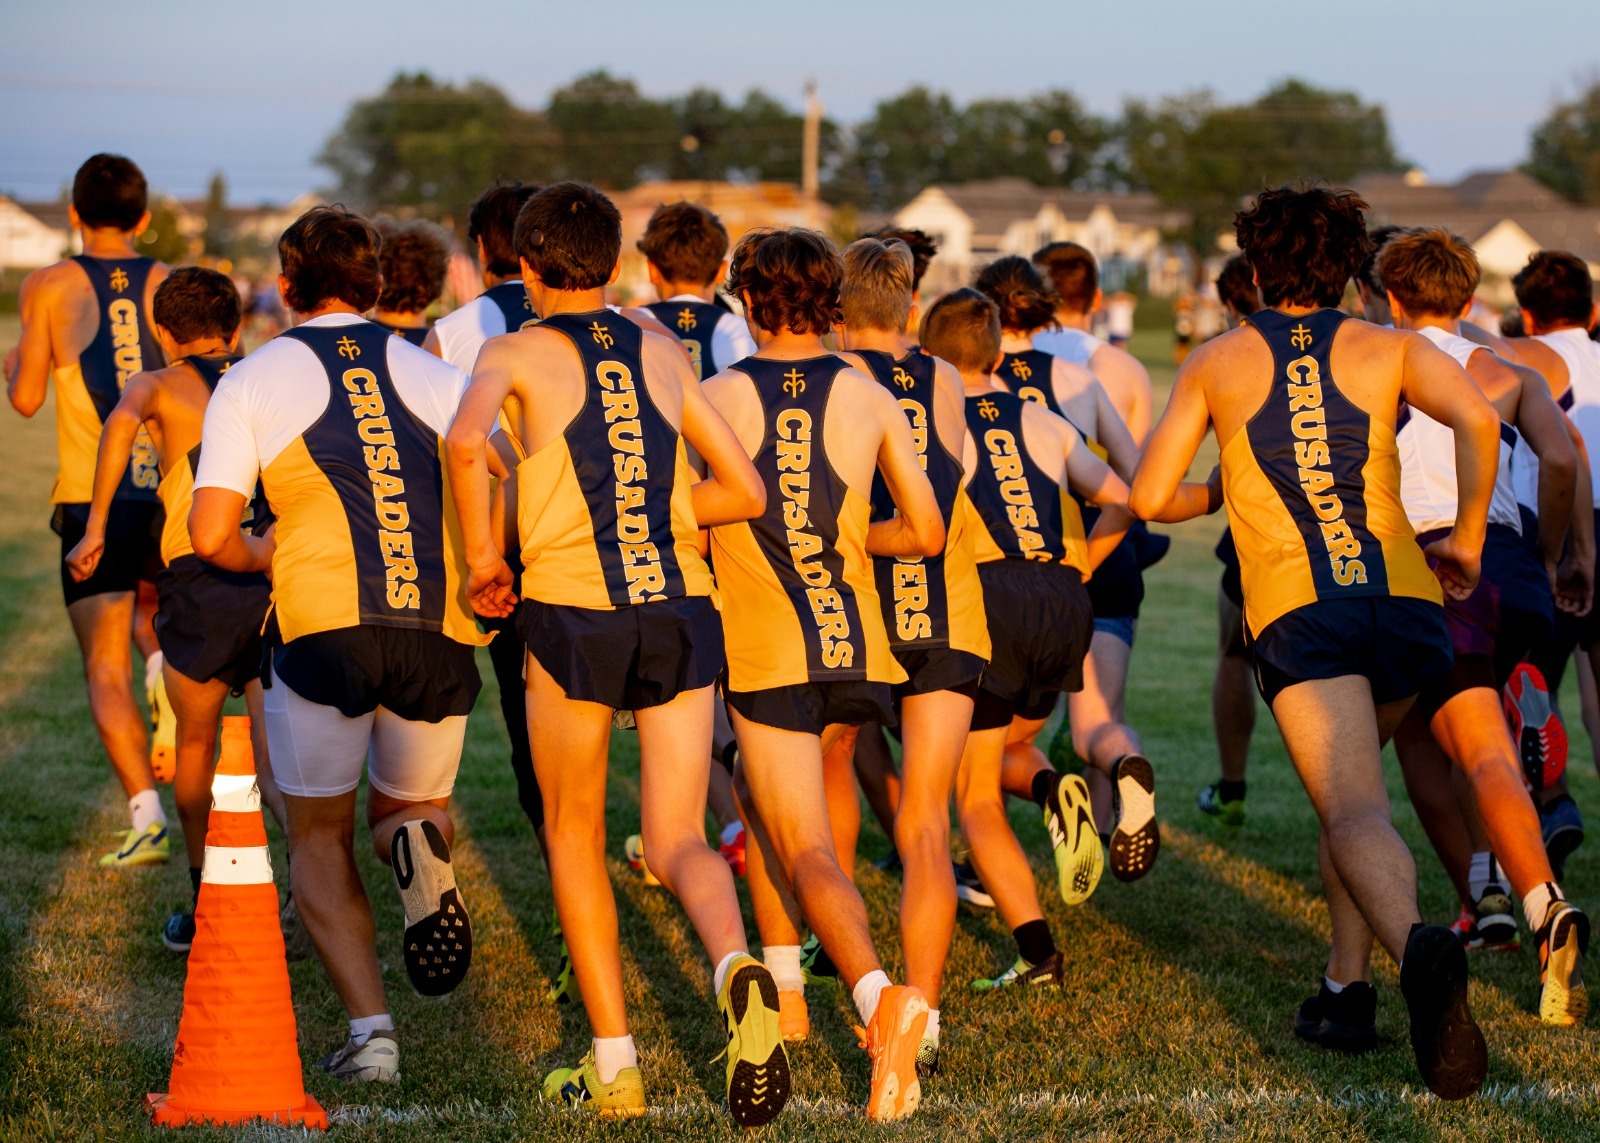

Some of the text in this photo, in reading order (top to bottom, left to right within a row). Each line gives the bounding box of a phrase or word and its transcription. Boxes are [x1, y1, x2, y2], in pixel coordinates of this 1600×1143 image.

[342, 367, 420, 610] CRUSADERS
[776, 408, 854, 669] CRUSADERS
[1286, 354, 1368, 586] CRUSADERS
